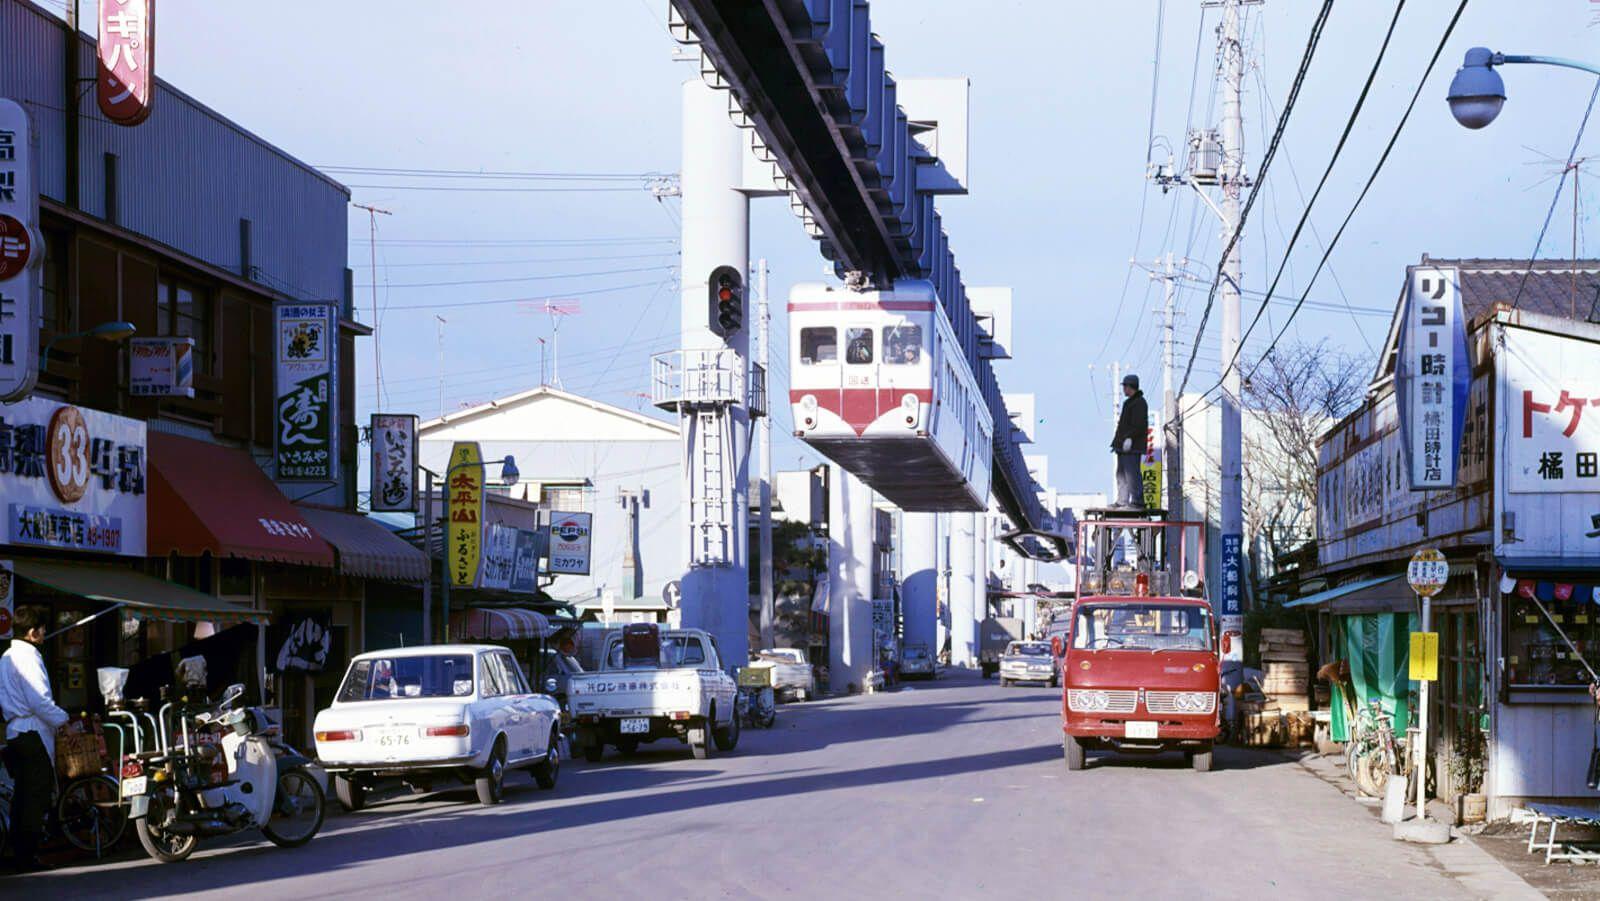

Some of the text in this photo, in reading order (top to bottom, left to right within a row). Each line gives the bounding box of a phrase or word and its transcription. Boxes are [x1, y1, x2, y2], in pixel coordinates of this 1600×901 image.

[107, 0, 139, 105] キパン
[1420, 278, 1447, 405] リコー時計
[57, 424, 87, 487] 33
[1422, 410, 1443, 482] 橘田時計店
[456, 528, 471, 585] ふるさと
[551, 526, 588, 537] PEPSI
